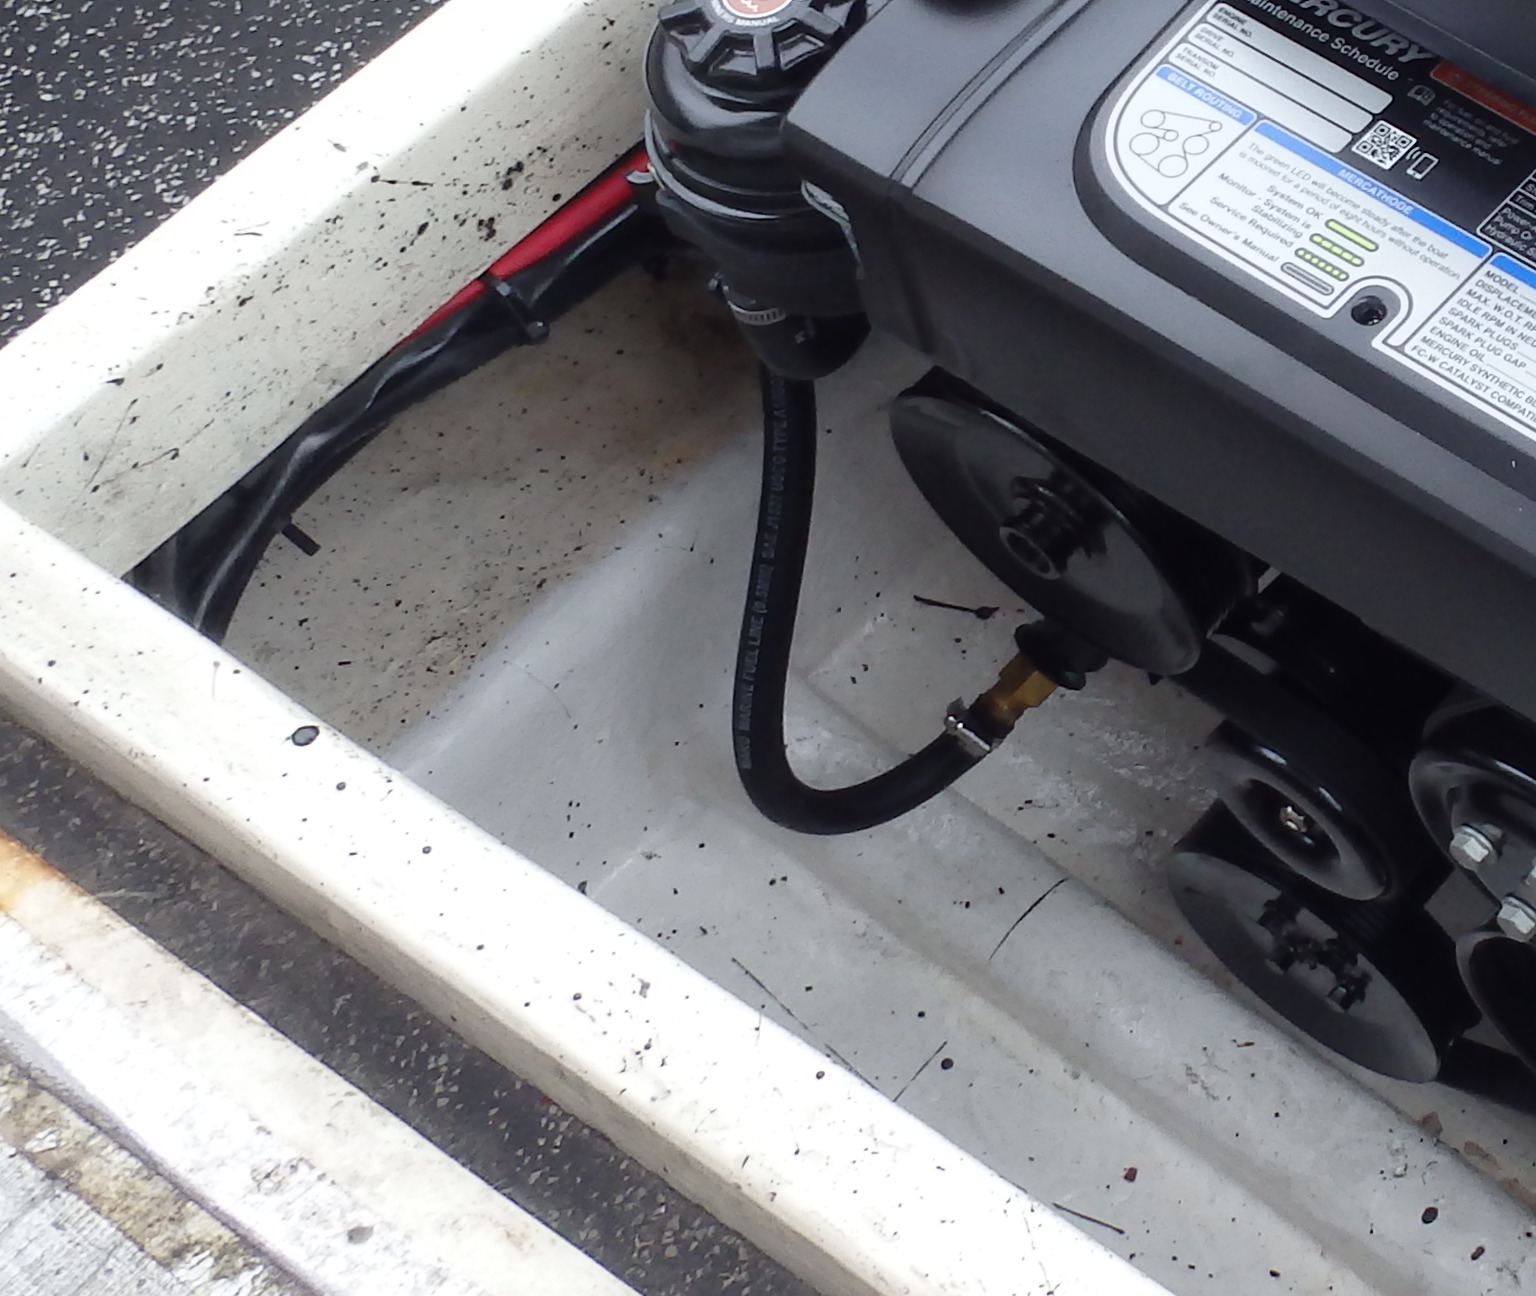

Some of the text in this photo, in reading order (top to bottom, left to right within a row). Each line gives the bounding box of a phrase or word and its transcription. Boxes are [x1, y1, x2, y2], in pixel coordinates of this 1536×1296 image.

[735, 16, 780, 26] MANUAL
[1330, 36, 1400, 81] Schedule
[1166, 71, 1243, 118] BELT ROUTING
[1218, 172, 1256, 197] Monitor
[1262, 198, 1301, 223] System
[1247, 156, 1281, 177] moored
[1299, 186, 1330, 205] period
[1338, 208, 1362, 224] eight
[1361, 220, 1387, 238] hours
[1387, 235, 1420, 256] without
[1248, 142, 1265, 155] The
[1263, 153, 1290, 171] green
[1290, 166, 1311, 181] LED
[1325, 187, 1361, 209] become
[1360, 207, 1390, 227] steady
[1390, 224, 1412, 238] after
[1426, 243, 1449, 259] boat
[1266, 185, 1323, 219] System OK
[1337, 168, 1414, 215] MERCATHODE
[1514, 194, 1535, 210] Trim
[1178, 202, 1279, 262] See Owner's Manual
[1209, 196, 1294, 248] Service Required
[1250, 204, 1303, 239] Stabilizing
[1484, 223, 1527, 251] Hydraulic
[1492, 214, 1521, 235] Pump
[1483, 270, 1519, 293] MODEL
[1447, 307, 1483, 330] SPARK
[1482, 326, 1519, 350] PLUGS
[1456, 297, 1481, 314] IDLE
[1480, 311, 1505, 327] RPM
[1492, 303, 1523, 323] W.O.T.
[1429, 325, 1469, 351] ENGINE
[1468, 348, 1486, 362] OIL
[1438, 316, 1474, 340] SPARK
[1473, 336, 1503, 356] PLUG
[1502, 353, 1527, 369] GAP
[1410, 344, 1439, 364] FC-W
[1438, 360, 1490, 393] CATALYST
[1420, 335, 1470, 366] MERCURY
[1468, 363, 1525, 399] SYNTHETIC
[773, 420, 789, 452] TYPE
[748, 615, 765, 646] LINE
[743, 649, 760, 681] FUEL
